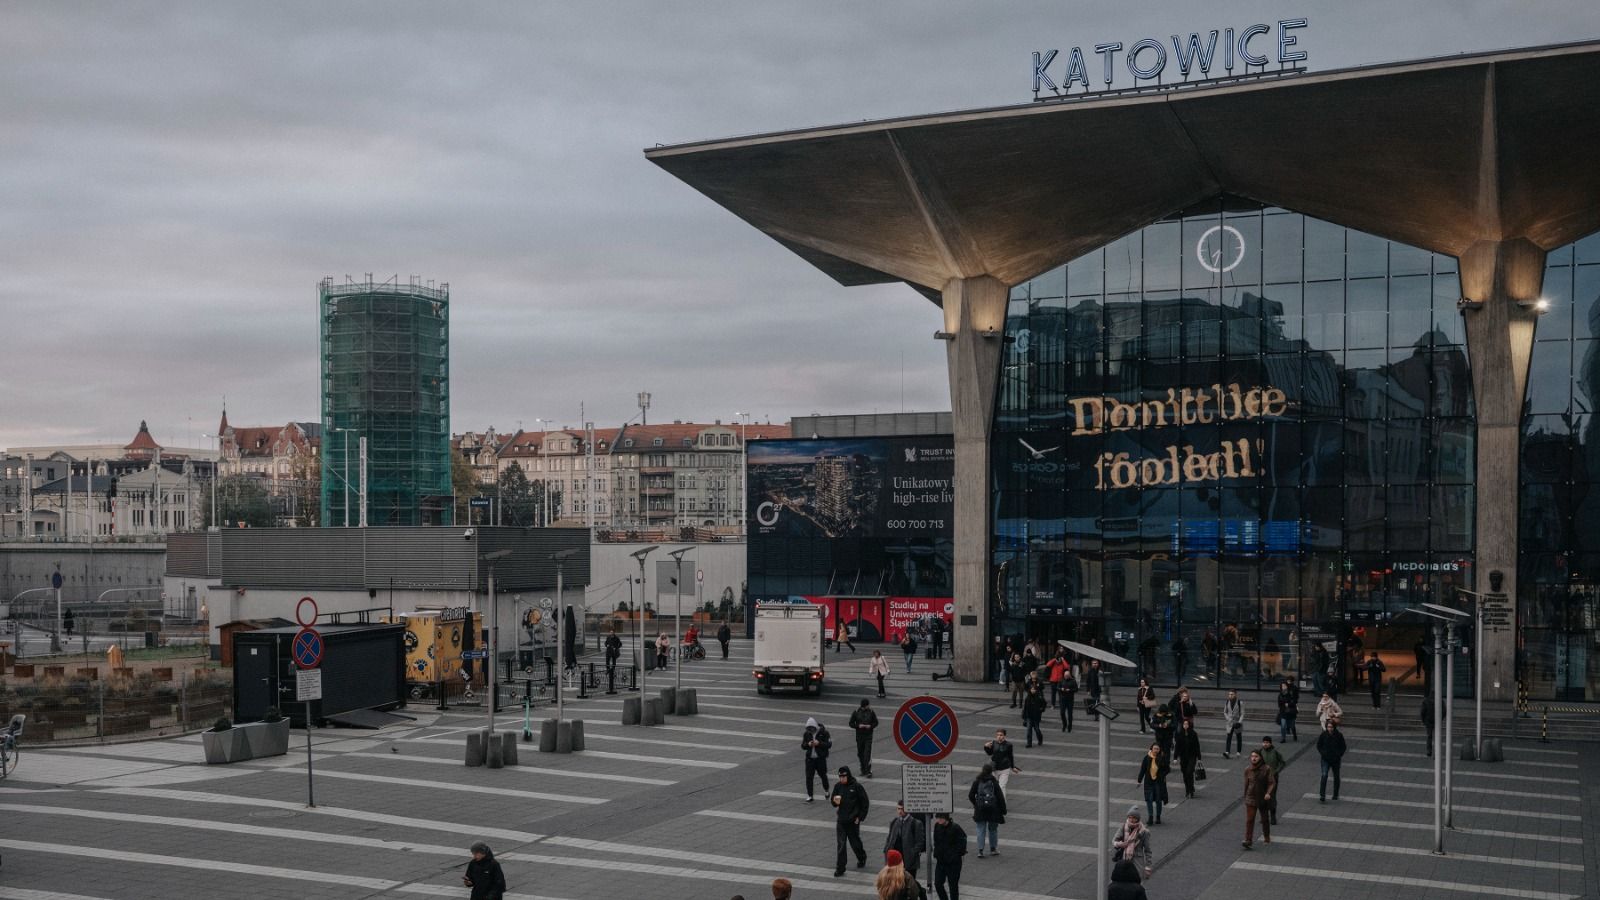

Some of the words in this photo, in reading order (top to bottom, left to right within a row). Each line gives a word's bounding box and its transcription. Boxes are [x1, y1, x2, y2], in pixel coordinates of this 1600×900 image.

[1032, 17, 1307, 92] KATOWICE
[920, 448, 944, 456] TRUST
[893, 476, 949, 491] Unikatowy
[893, 491, 939, 507] high-rise
[887, 519, 906, 529] 600
[907, 519, 927, 529] 700
[928, 519, 944, 529] 713
[1392, 562, 1459, 571] McDonald's
[889, 601, 917, 611] Studiuj
[919, 602, 929, 610] na
[889, 610, 944, 620] Uniwersytecie
[889, 618, 920, 628] Śląskim
